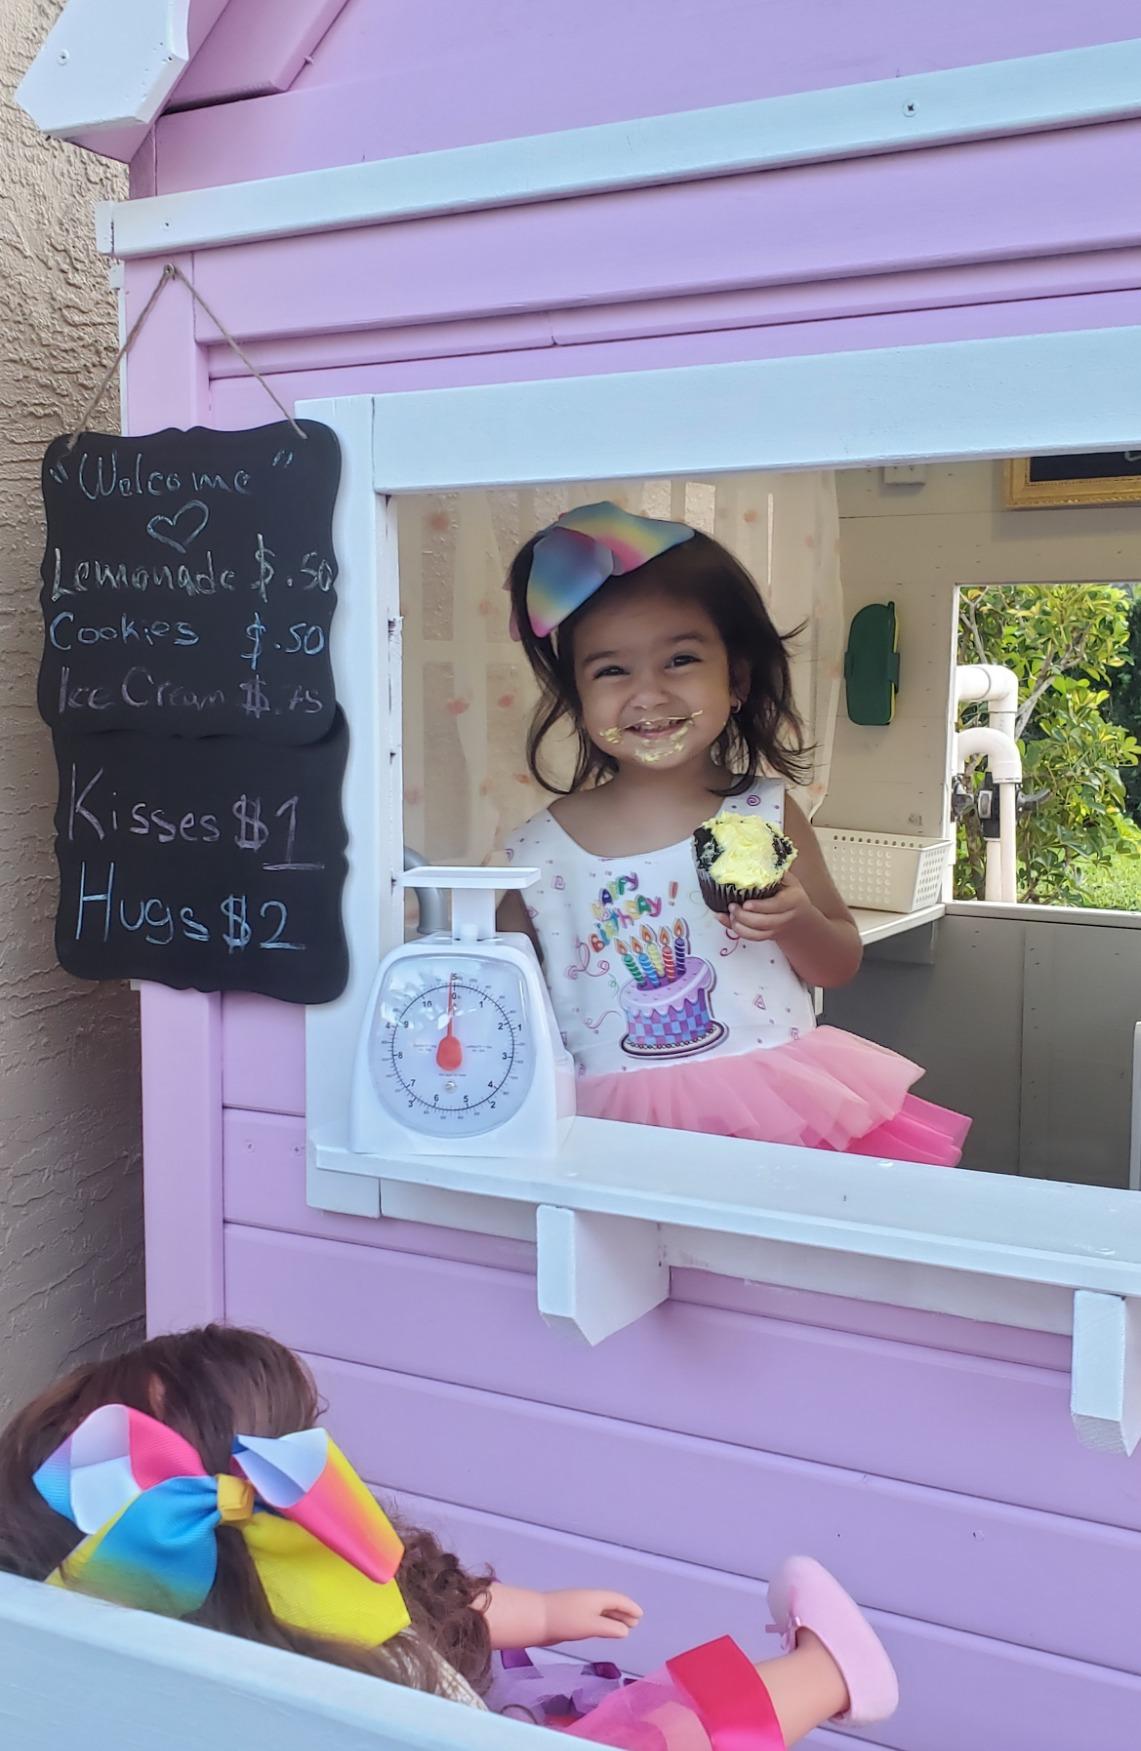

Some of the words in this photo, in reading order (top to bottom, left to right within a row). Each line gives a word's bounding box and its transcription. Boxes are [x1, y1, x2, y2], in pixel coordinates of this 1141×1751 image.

[52, 548, 236, 602] Lemonade
[50, 611, 200, 650] Cookies
[68, 762, 222, 843] Kisses
[75, 861, 209, 944] Hugs
[221, 894, 306, 954] $2
